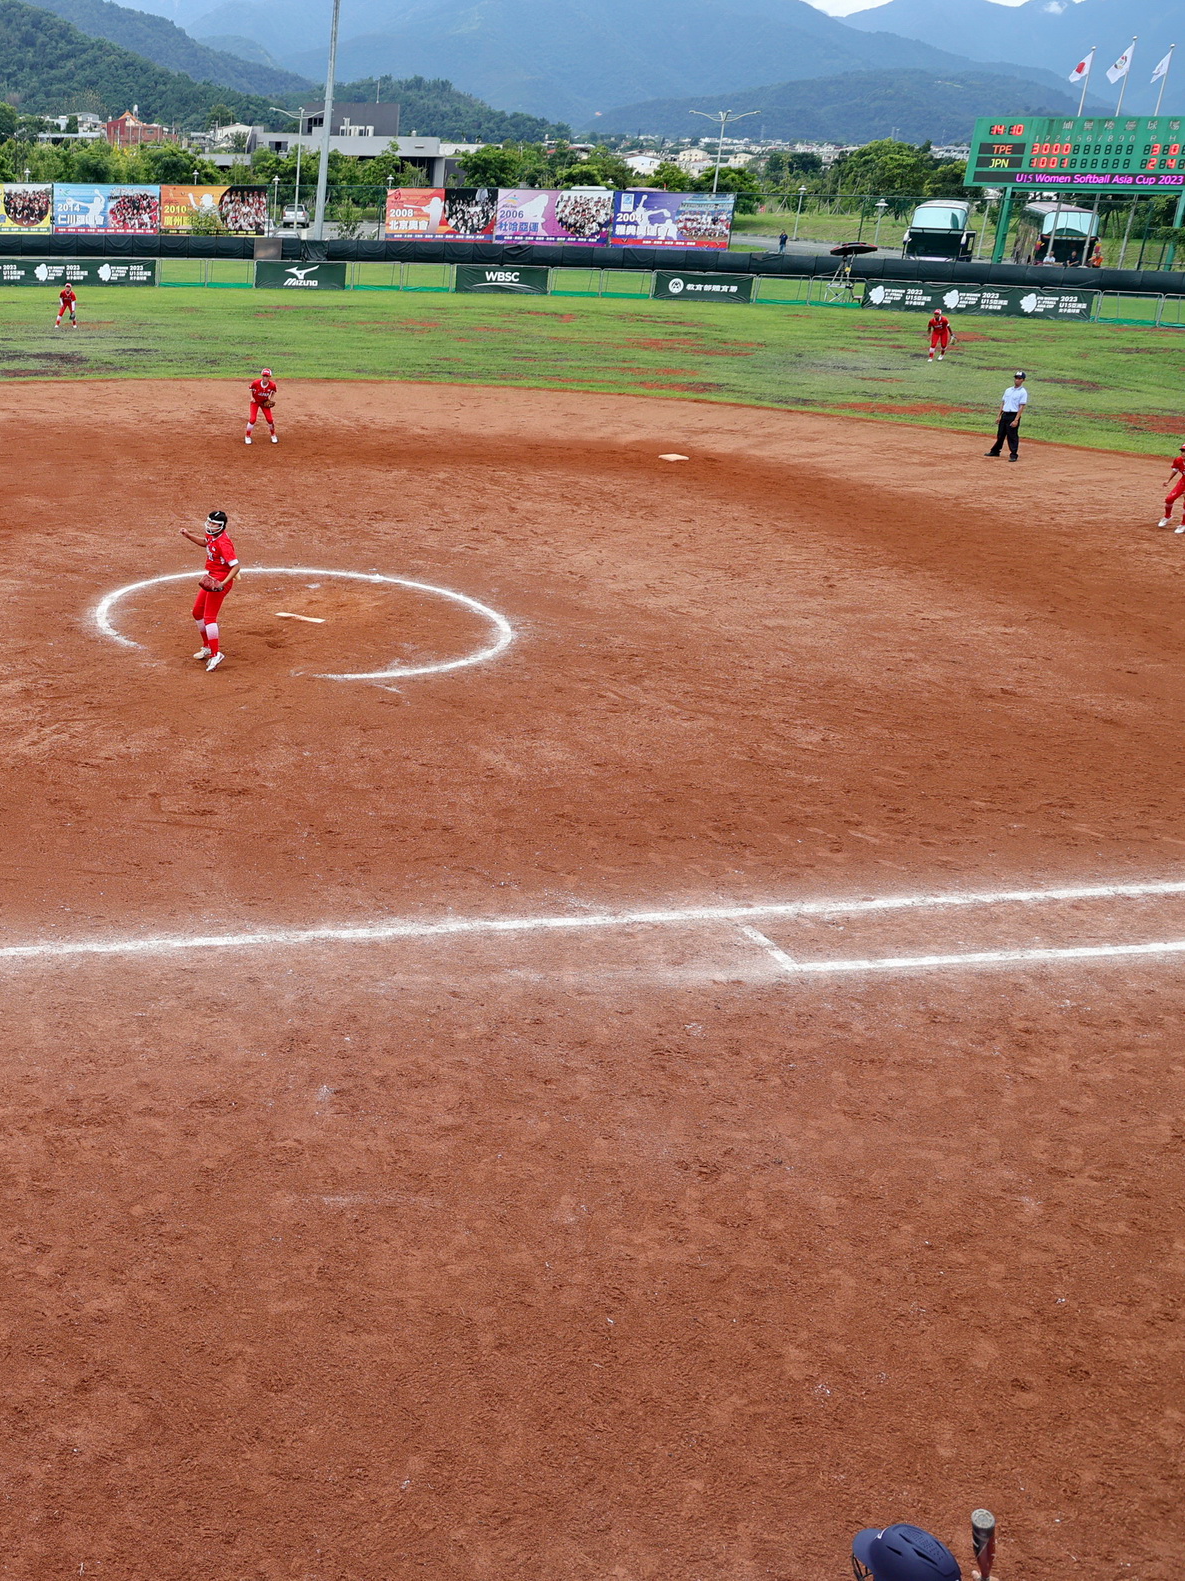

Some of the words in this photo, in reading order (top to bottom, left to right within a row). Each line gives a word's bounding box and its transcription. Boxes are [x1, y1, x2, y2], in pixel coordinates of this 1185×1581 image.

[992, 145, 1013, 154] TPE
[1031, 143, 1040, 154] 3
[1041, 143, 1051, 155] 0
[1051, 143, 1061, 155] 0
[1061, 143, 1071, 155] 0
[1151, 144, 1161, 155] 3
[989, 159, 1009, 168] JPN
[1038, 157, 1048, 168] 0
[1048, 157, 1058, 168] 0
[1146, 158, 1158, 170] 2
[1166, 158, 1176, 169] 4
[1016, 174, 1033, 183] U15
[1035, 174, 1071, 183] Women
[1073, 174, 1111, 184] Softball
[1112, 175, 1133, 184] Asia
[1135, 175, 1156, 185] Cup
[1158, 175, 1184, 184] 2023
[390, 209, 413, 217] 2008
[500, 210, 524, 218] 2006
[499, 222, 539, 232] 杜哈亞運
[485, 271, 520, 282] WBSC
